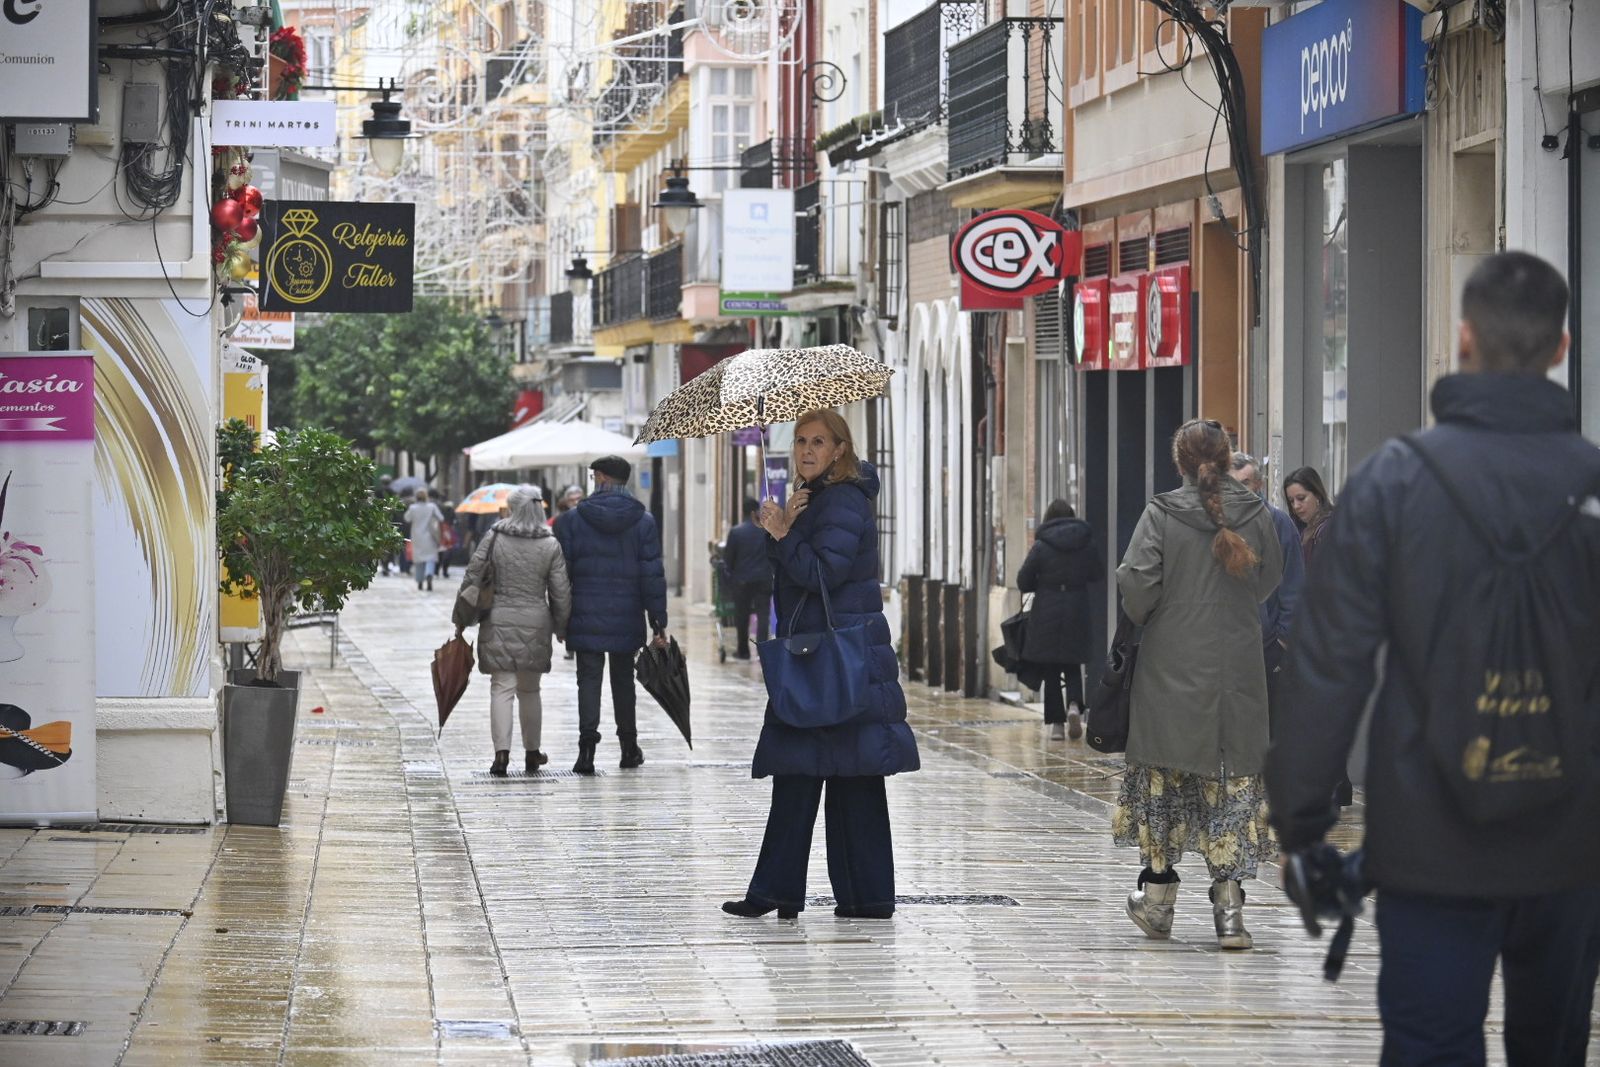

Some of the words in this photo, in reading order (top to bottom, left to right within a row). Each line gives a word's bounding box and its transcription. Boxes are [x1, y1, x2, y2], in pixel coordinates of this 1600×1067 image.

[226, 120, 262, 128] TRINI
[268, 121, 320, 129] MARTOS
[332, 222, 408, 258] Relojería
[343, 263, 397, 289] Taller
[726, 301, 758, 309] CENTRO
